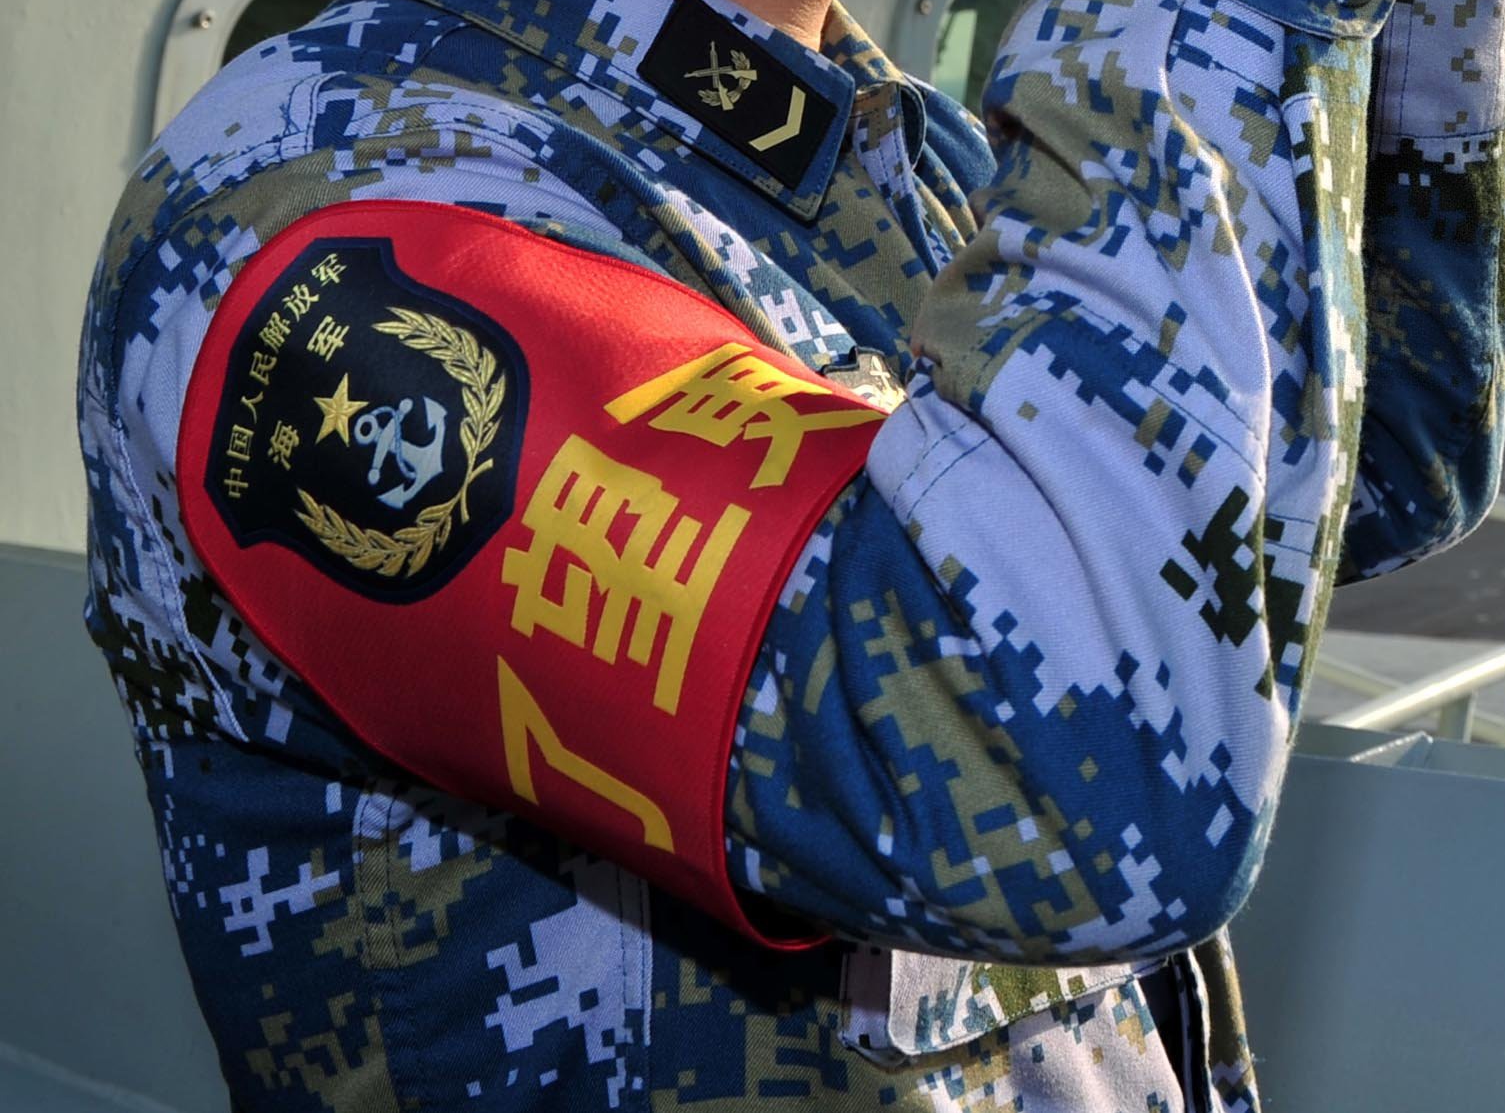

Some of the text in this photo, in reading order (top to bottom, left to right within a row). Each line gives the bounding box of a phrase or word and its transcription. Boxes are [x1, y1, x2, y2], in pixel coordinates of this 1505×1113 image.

[223, 253, 347, 499] 中国人民解放军
[267, 315, 350, 470] 海军
[497, 342, 889, 854] 了望更
